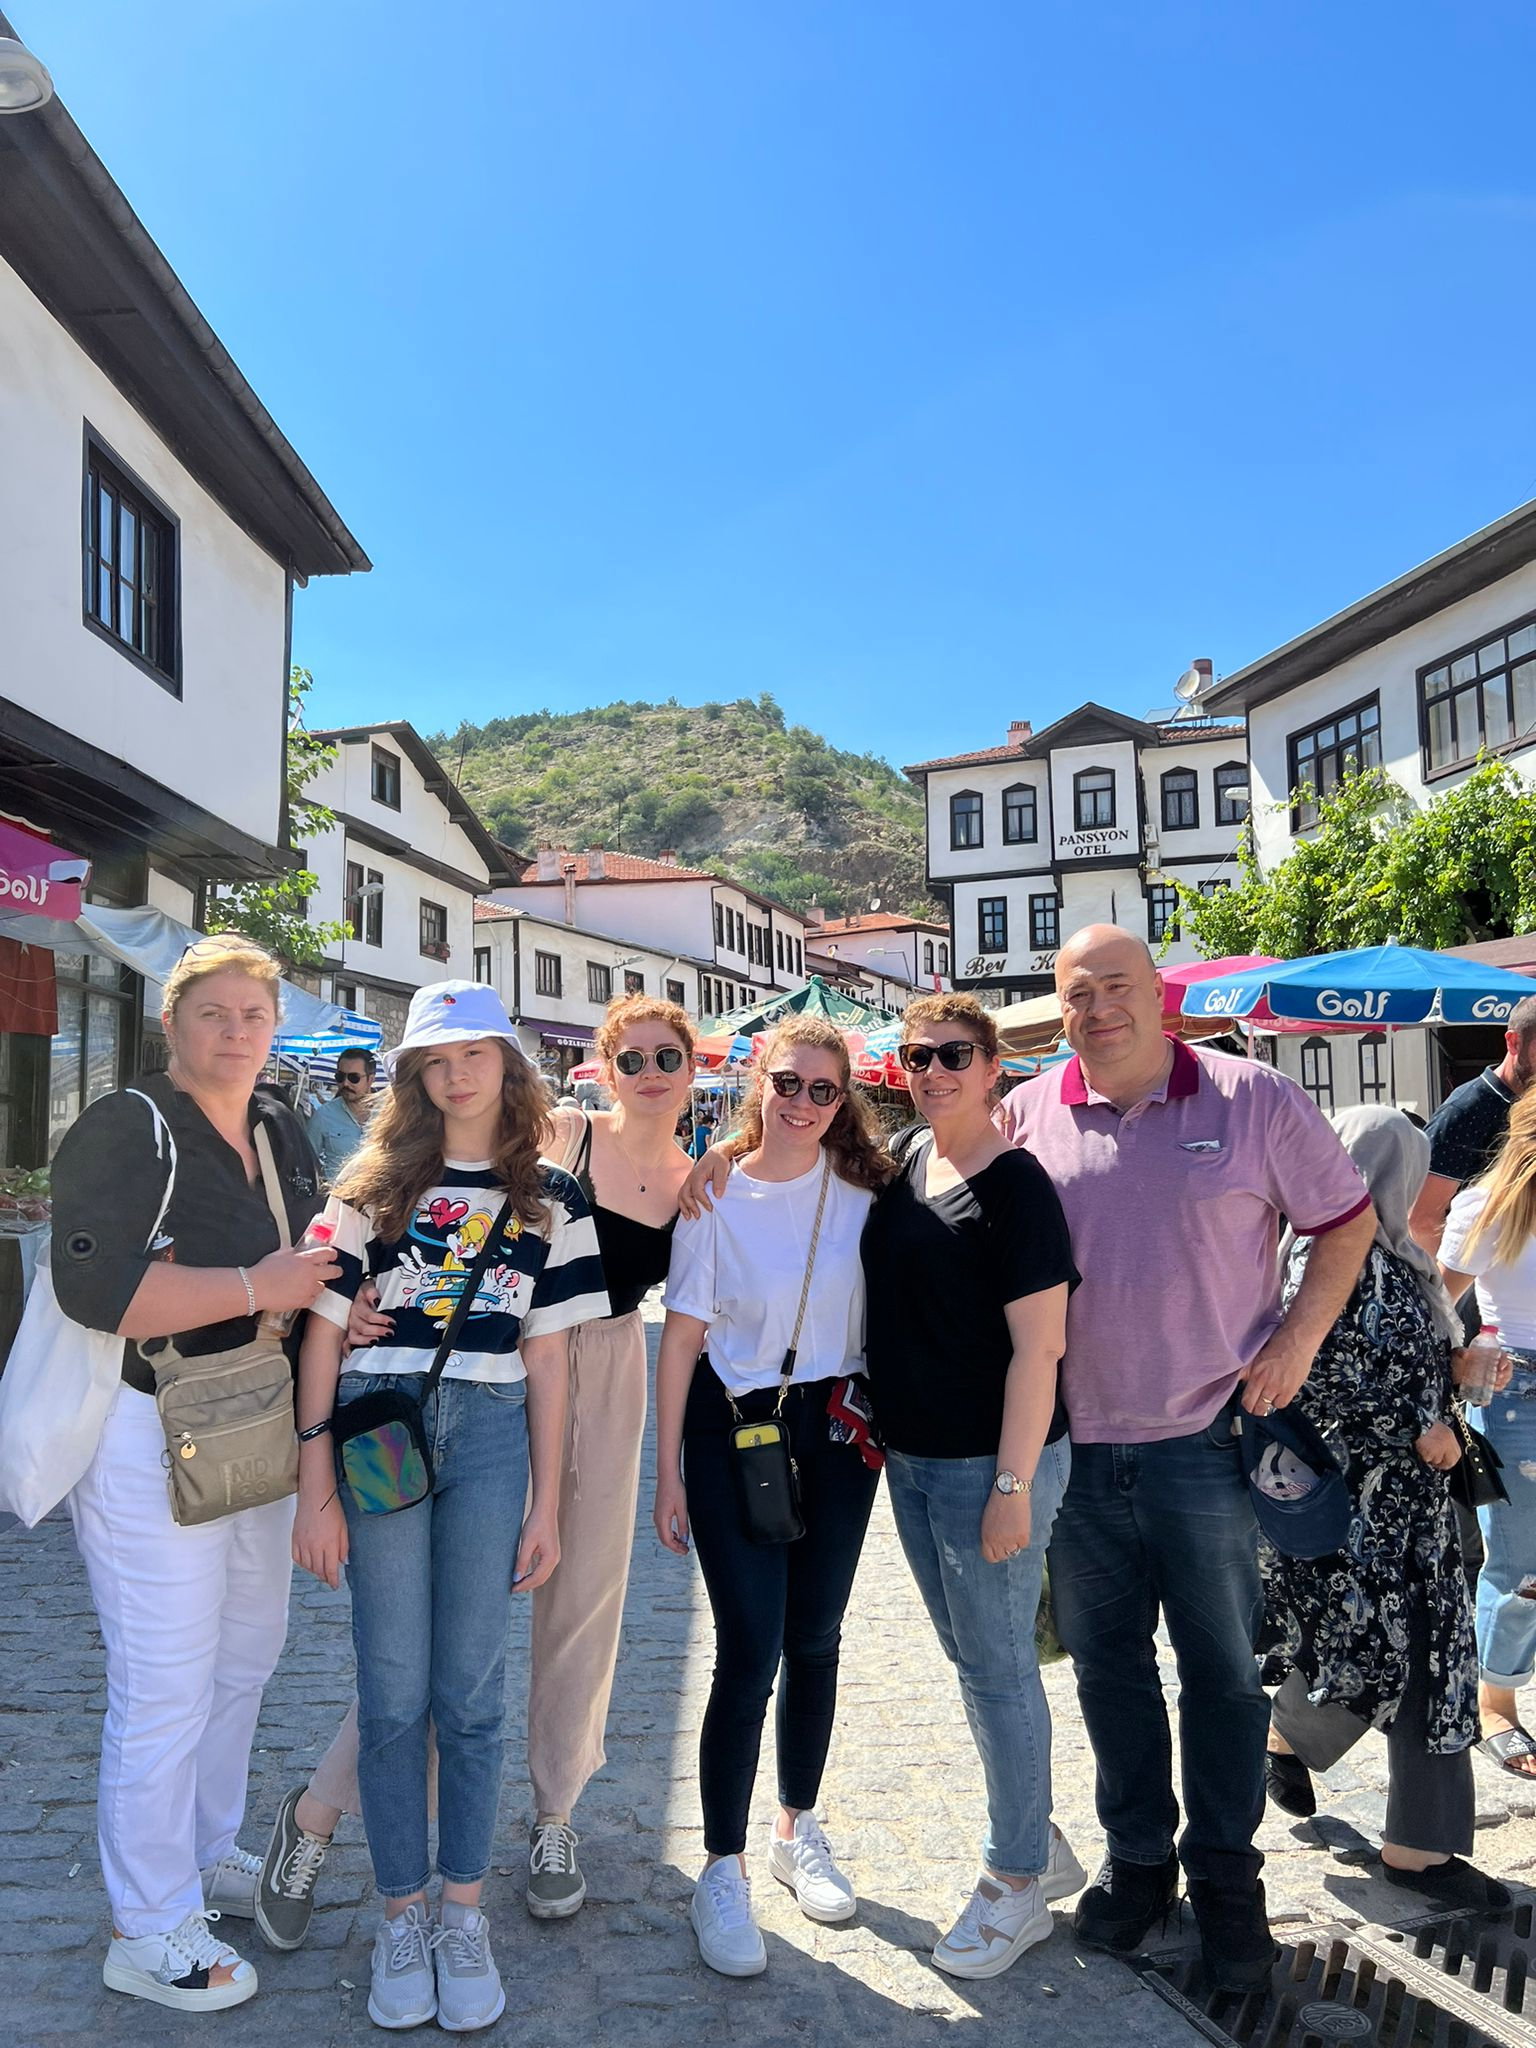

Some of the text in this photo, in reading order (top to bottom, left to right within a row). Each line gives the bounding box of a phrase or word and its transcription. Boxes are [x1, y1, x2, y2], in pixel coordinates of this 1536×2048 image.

[1073, 844, 1111, 856] OTEL
[964, 956, 1007, 978] Bey
[1204, 987, 1244, 1012] Golf
[1316, 989, 1391, 1019] Golf
